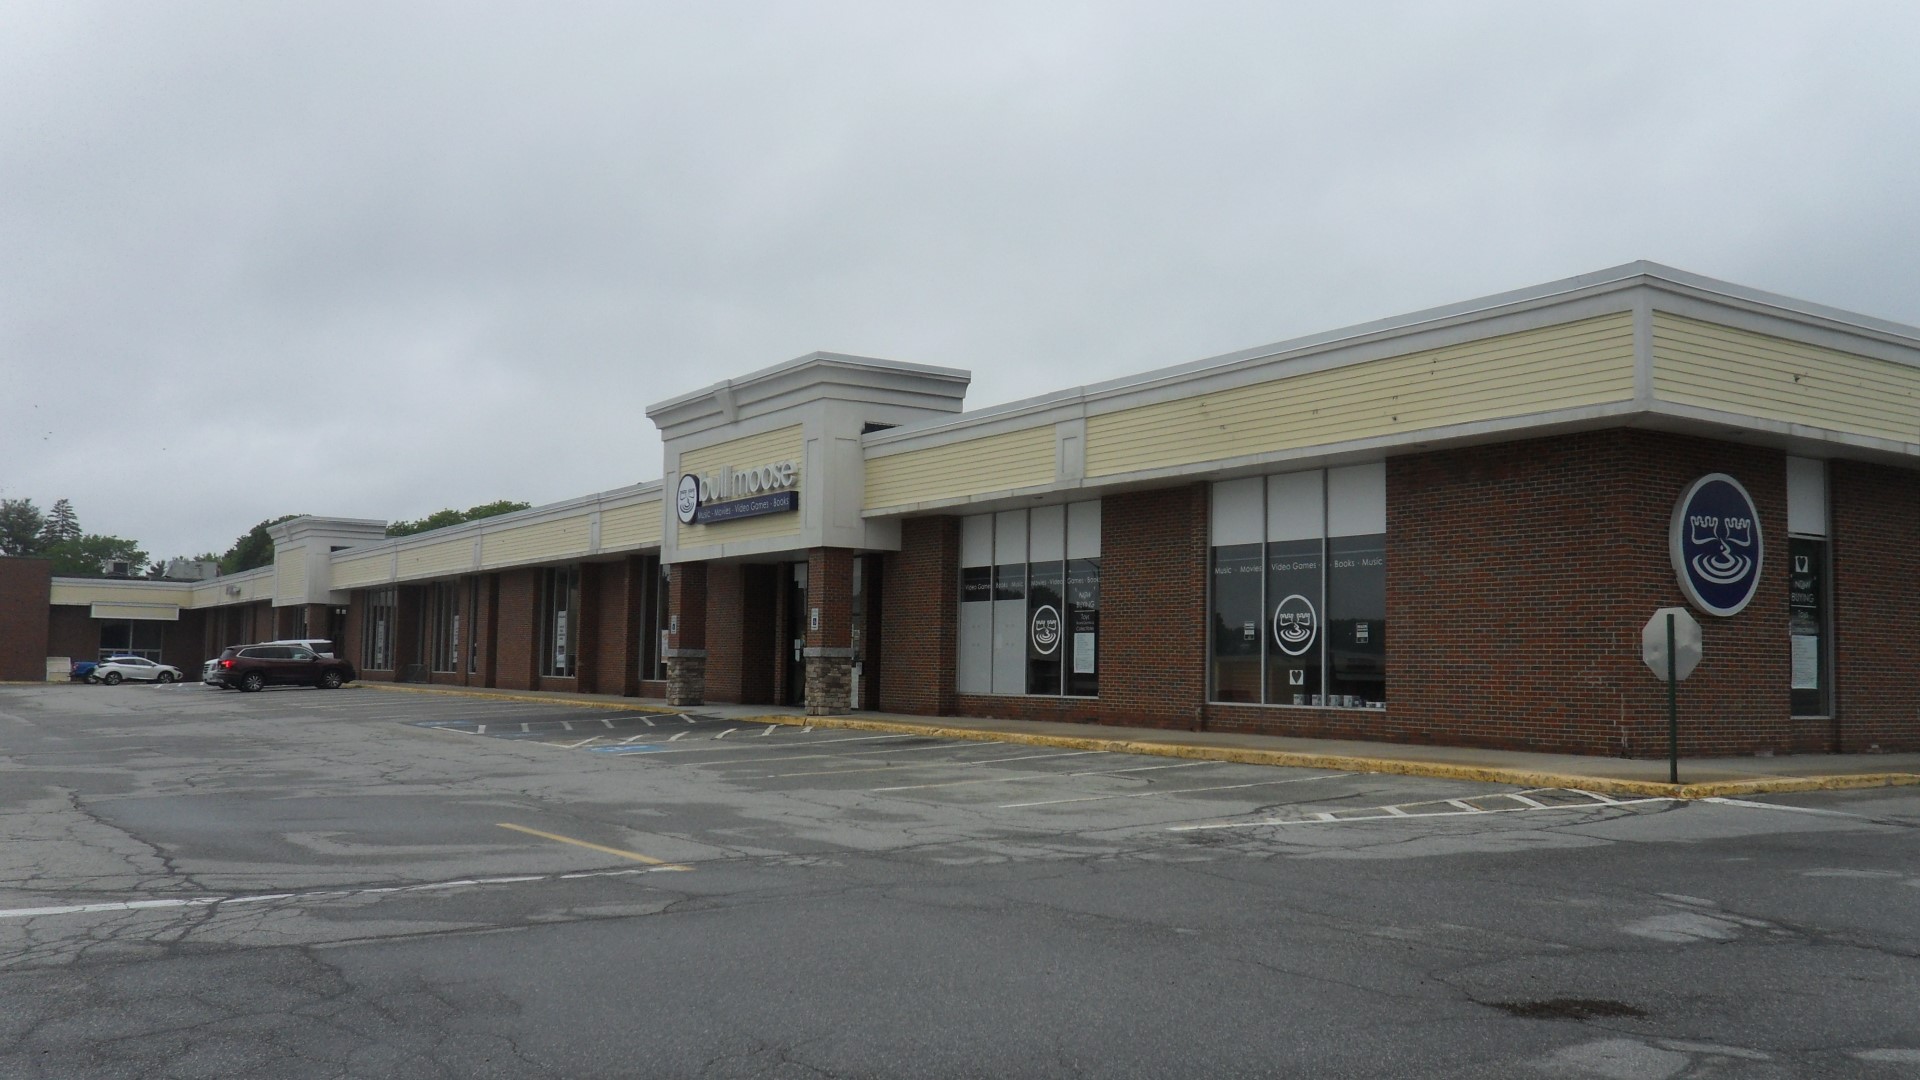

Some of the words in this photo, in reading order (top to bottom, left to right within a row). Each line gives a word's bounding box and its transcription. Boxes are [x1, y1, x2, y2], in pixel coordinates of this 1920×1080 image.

[714, 507, 731, 516] Movies
[734, 503, 750, 513] Video
[750, 500, 769, 511] Games
[773, 497, 790, 507] Books
[1214, 566, 1232, 575] Music
[1240, 565, 1263, 573] Movies
[1271, 562, 1291, 571] Video
[1292, 561, 1317, 570] Games
[1334, 559, 1355, 568] Books
[1361, 556, 1383, 566] Music
[1087, 576, 1100, 584] Book
